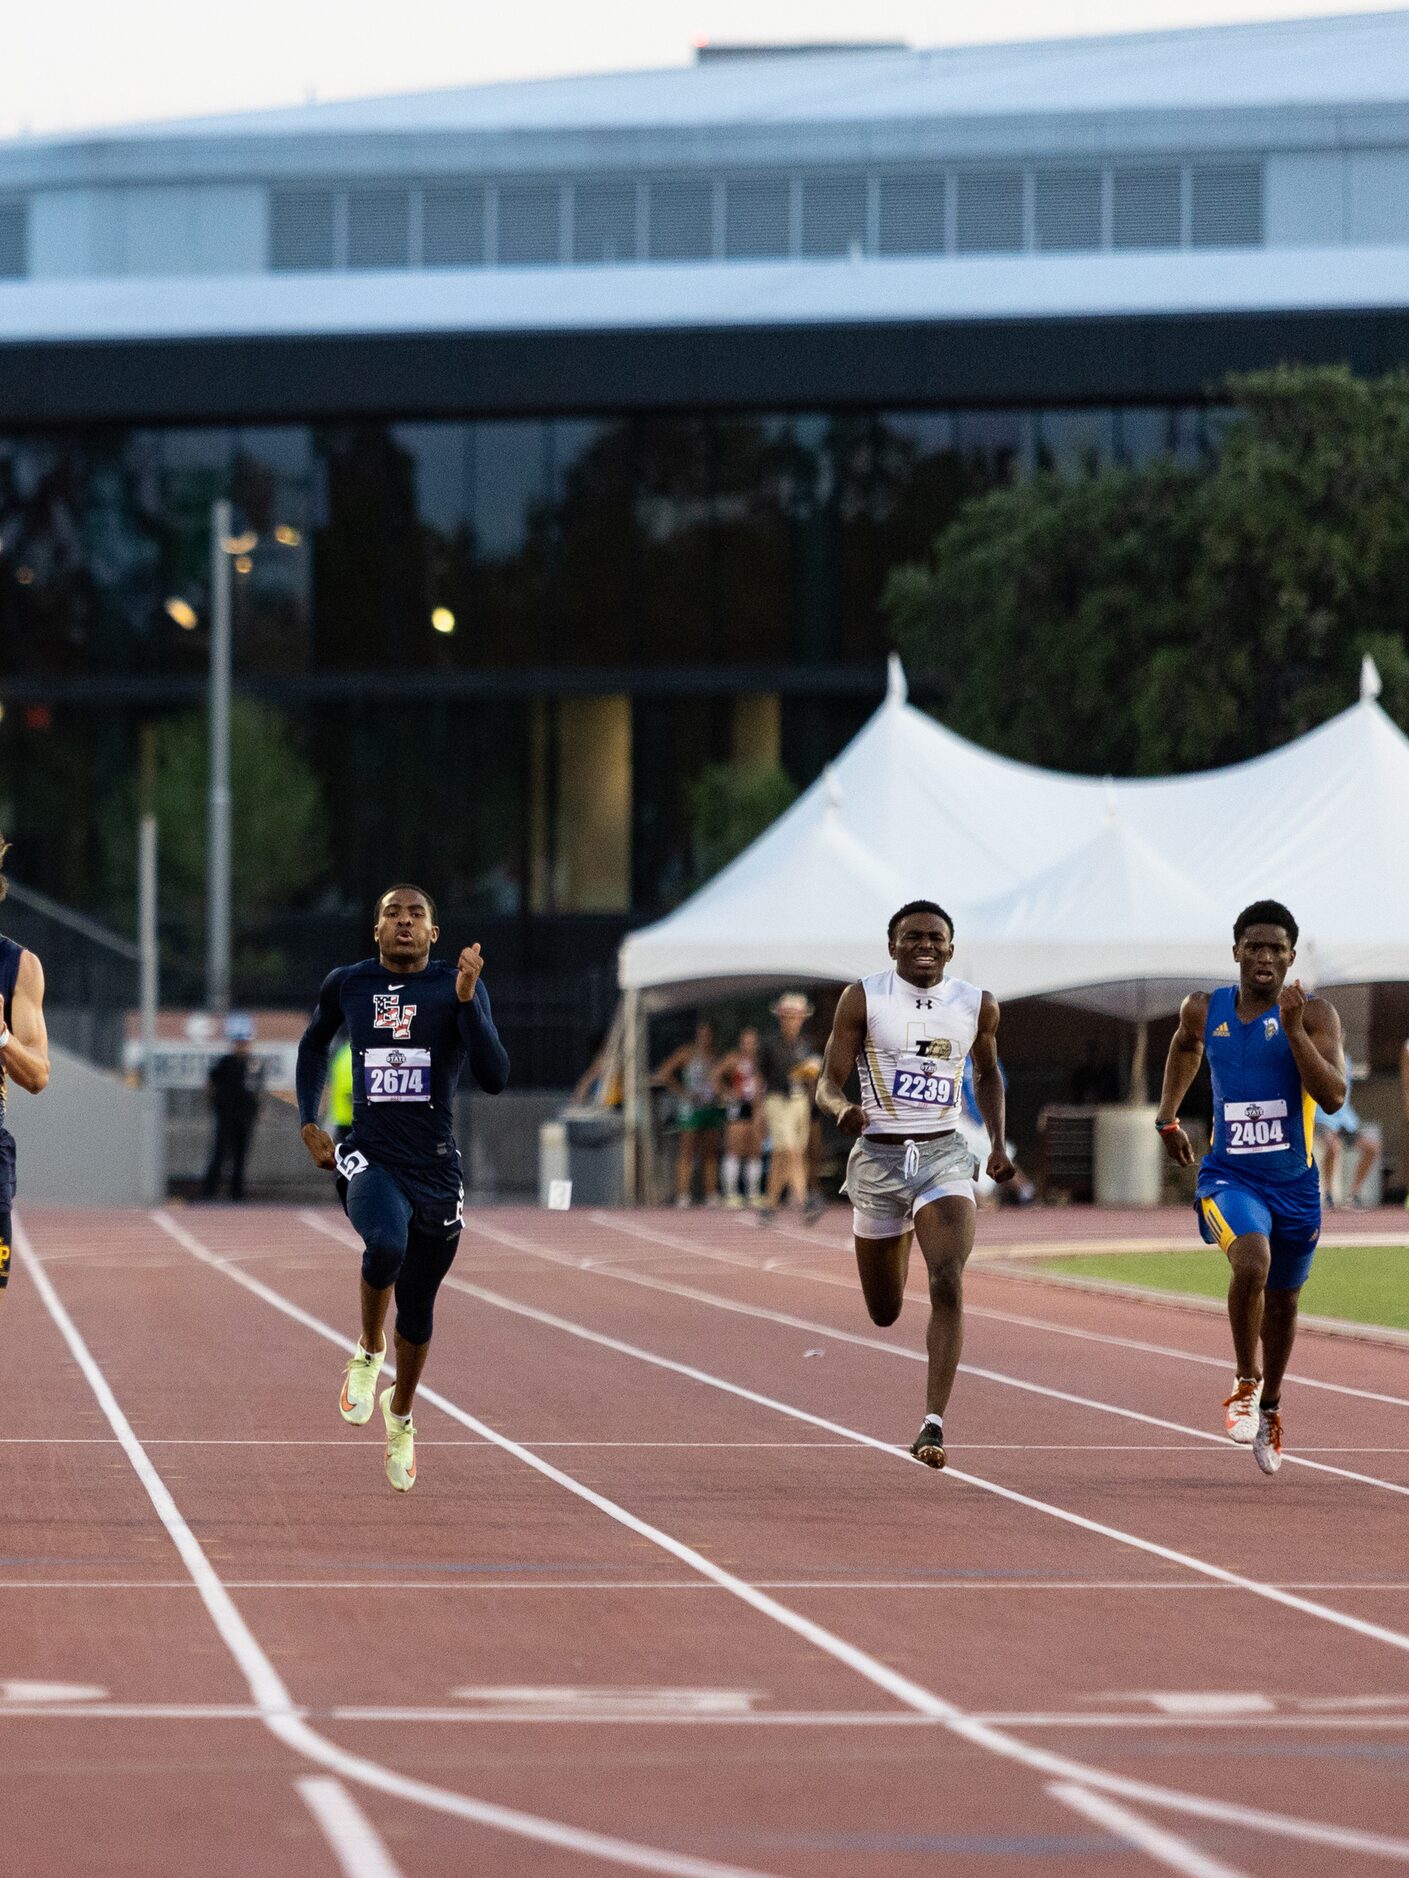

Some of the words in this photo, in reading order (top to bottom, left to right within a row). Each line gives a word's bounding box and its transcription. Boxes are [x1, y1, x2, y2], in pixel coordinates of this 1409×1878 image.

[373, 995, 417, 1040] EV
[370, 1068, 423, 1094] 2674
[897, 1073, 951, 1103] 2239
[1230, 1120, 1284, 1146] 2404
